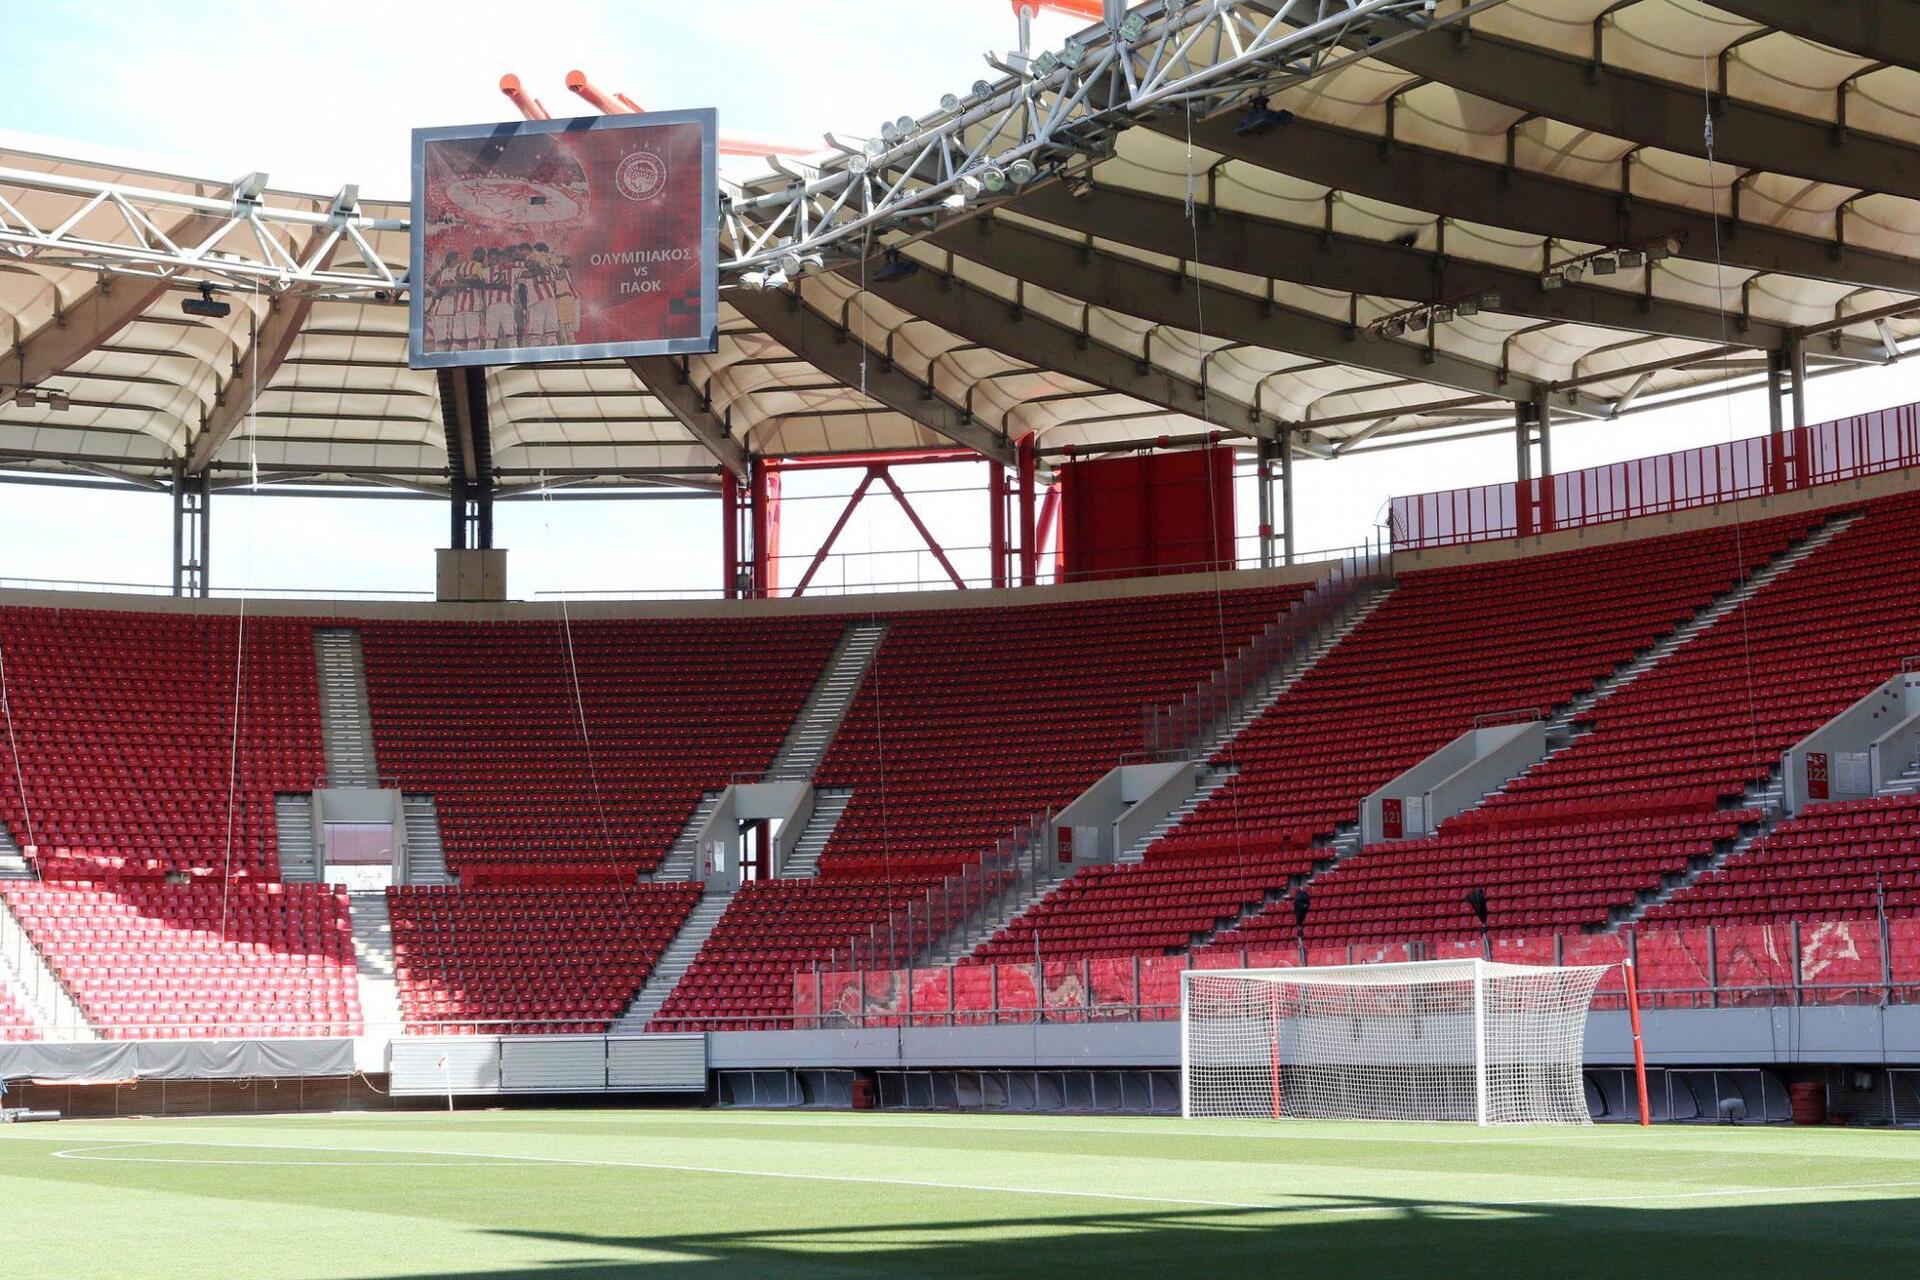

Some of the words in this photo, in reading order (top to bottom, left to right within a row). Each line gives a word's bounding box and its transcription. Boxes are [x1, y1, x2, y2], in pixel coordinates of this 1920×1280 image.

[590, 248, 692, 266] ΟΛΥΜΠΙΑΚΟΣ
[620, 280, 662, 294] ΠΑΟΚ
[1807, 767, 1827, 781] 122
[1383, 811, 1401, 824] 121
